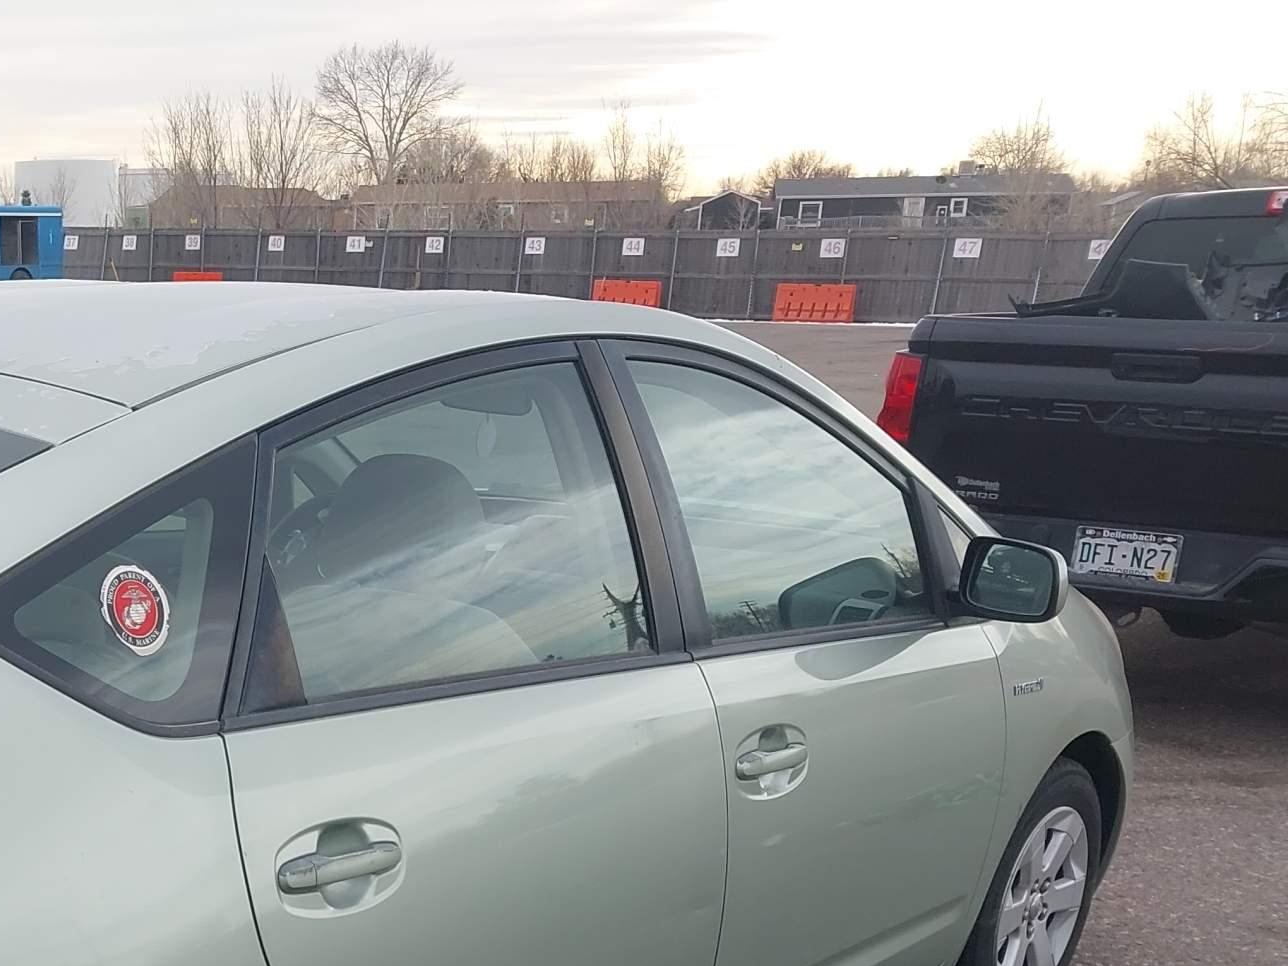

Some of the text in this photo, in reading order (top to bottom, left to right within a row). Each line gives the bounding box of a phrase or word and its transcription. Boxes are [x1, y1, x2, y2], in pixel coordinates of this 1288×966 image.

[271, 237, 282, 249] 40
[349, 238, 362, 249] 41
[428, 239, 441, 251] 42
[528, 239, 542, 251] 43
[625, 240, 641, 252] 44
[720, 241, 735, 253] 45
[824, 241, 841, 254] 46
[958, 241, 978, 255] 47
[1102, 530, 1156, 542] Dellenbach
[107, 579, 119, 604] PROUD
[120, 573, 146, 583] PARENT
[147, 582, 156, 592] OF
[136, 629, 160, 647] MARINE
